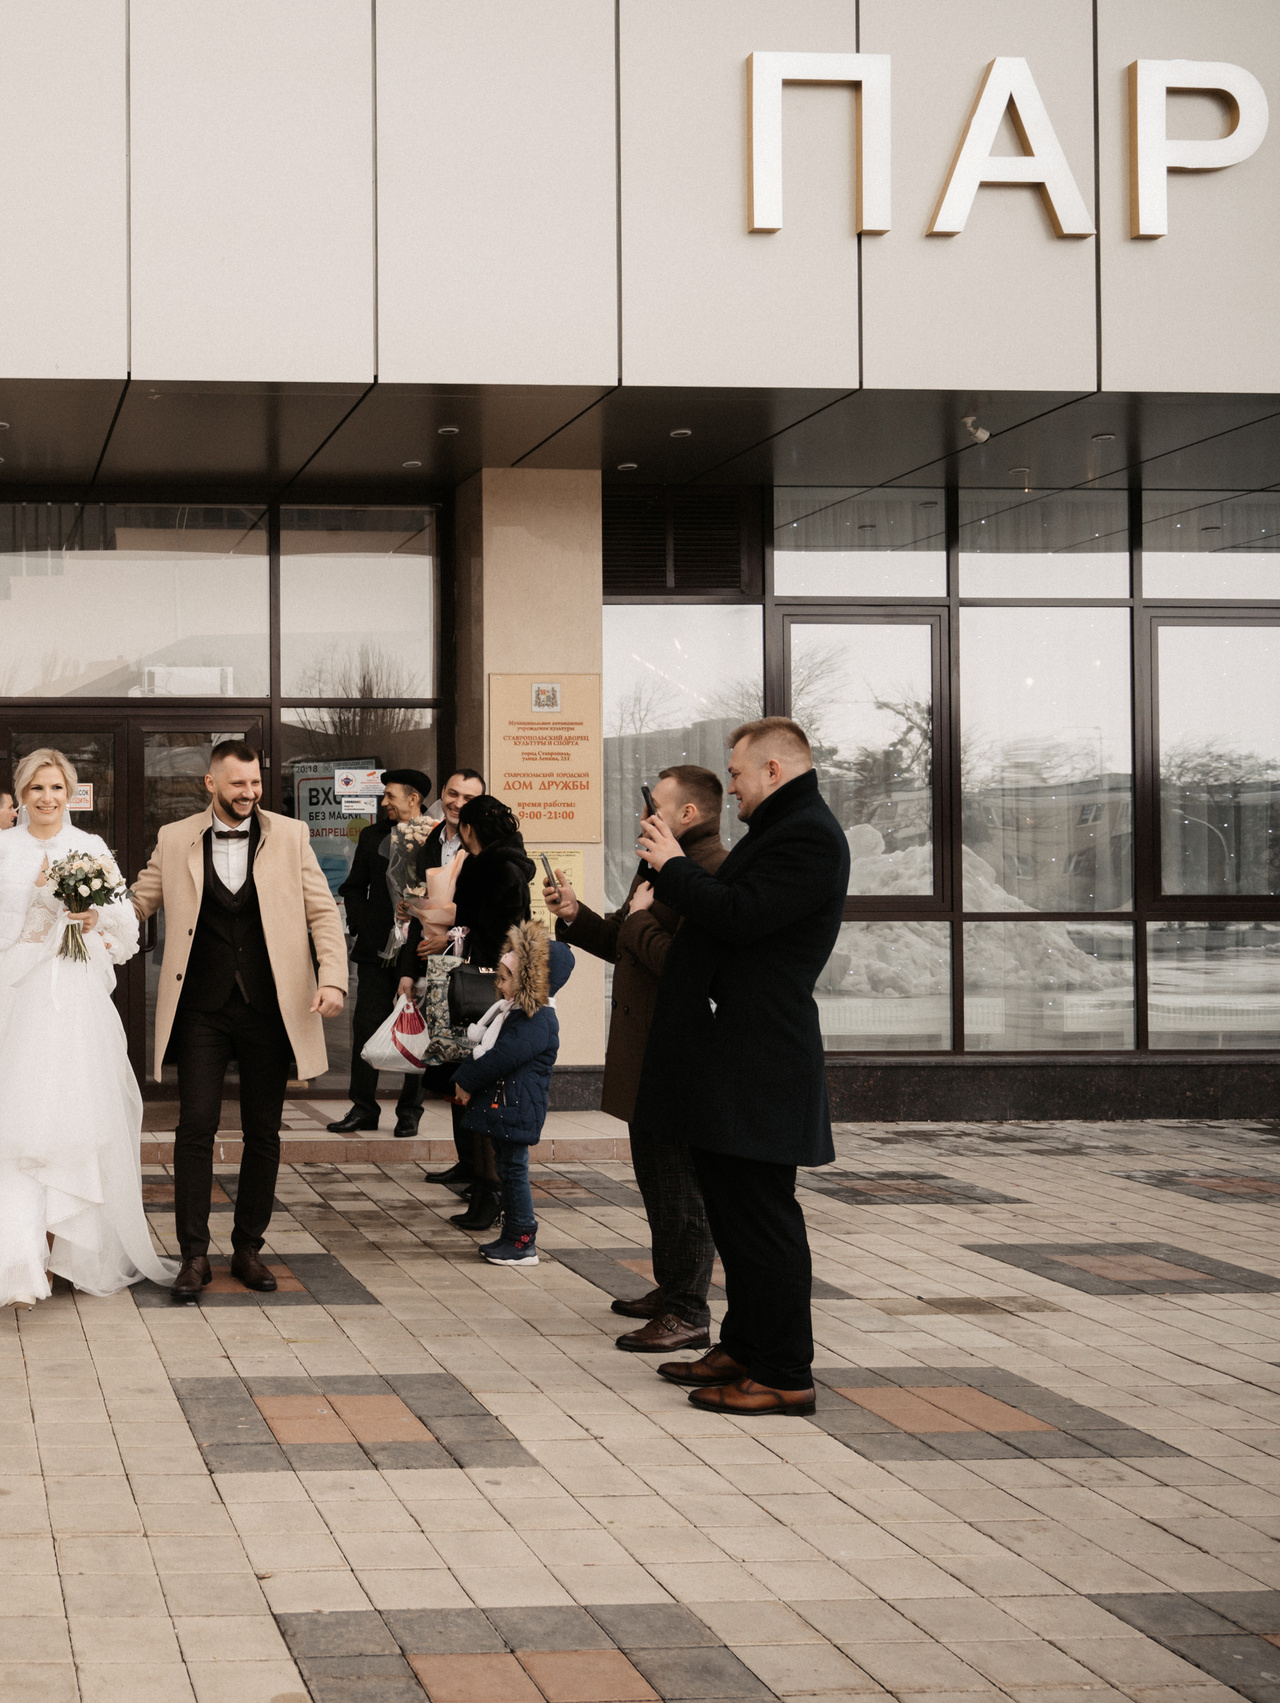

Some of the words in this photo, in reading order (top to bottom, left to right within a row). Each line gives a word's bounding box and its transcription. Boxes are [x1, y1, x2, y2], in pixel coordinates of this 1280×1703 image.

[746, 51, 1269, 240] ПАР
[295, 765, 318, 774] 20:18
[503, 780, 533, 790] ДОМ
[538, 780, 590, 790] ДРУЖБЫ
[543, 800, 576, 809] работы:
[308, 812, 326, 821] БЕЗ
[328, 811, 361, 820] МАСКИ
